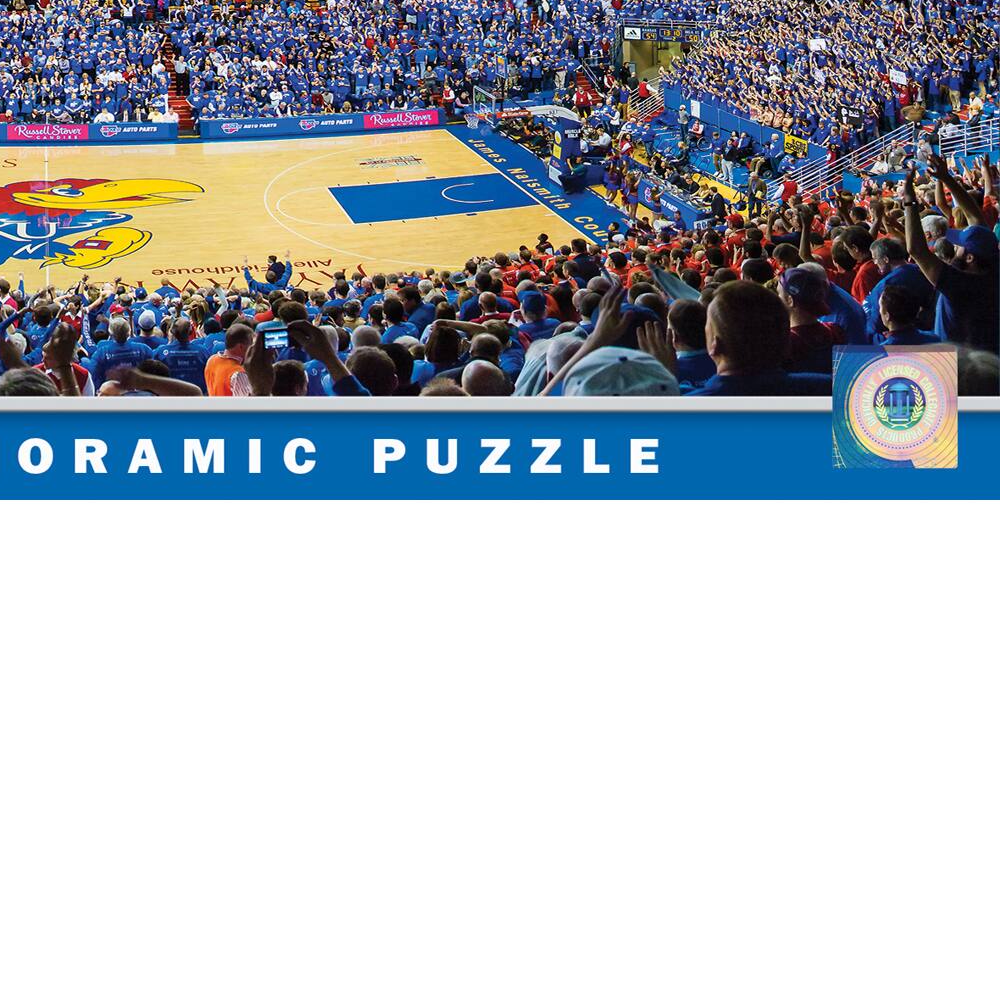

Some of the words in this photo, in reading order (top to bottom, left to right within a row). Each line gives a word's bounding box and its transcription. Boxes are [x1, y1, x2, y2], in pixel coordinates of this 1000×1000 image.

[370, 113, 403, 125] Russell
[404, 112, 432, 122] Stover
[14, 125, 49, 138] Russell
[50, 125, 81, 135] Stover
[468, 138, 507, 163] James
[507, 168, 571, 210] Naismith
[293, 258, 332, 268] Alle
[373, 437, 661, 475] PUZZLE
